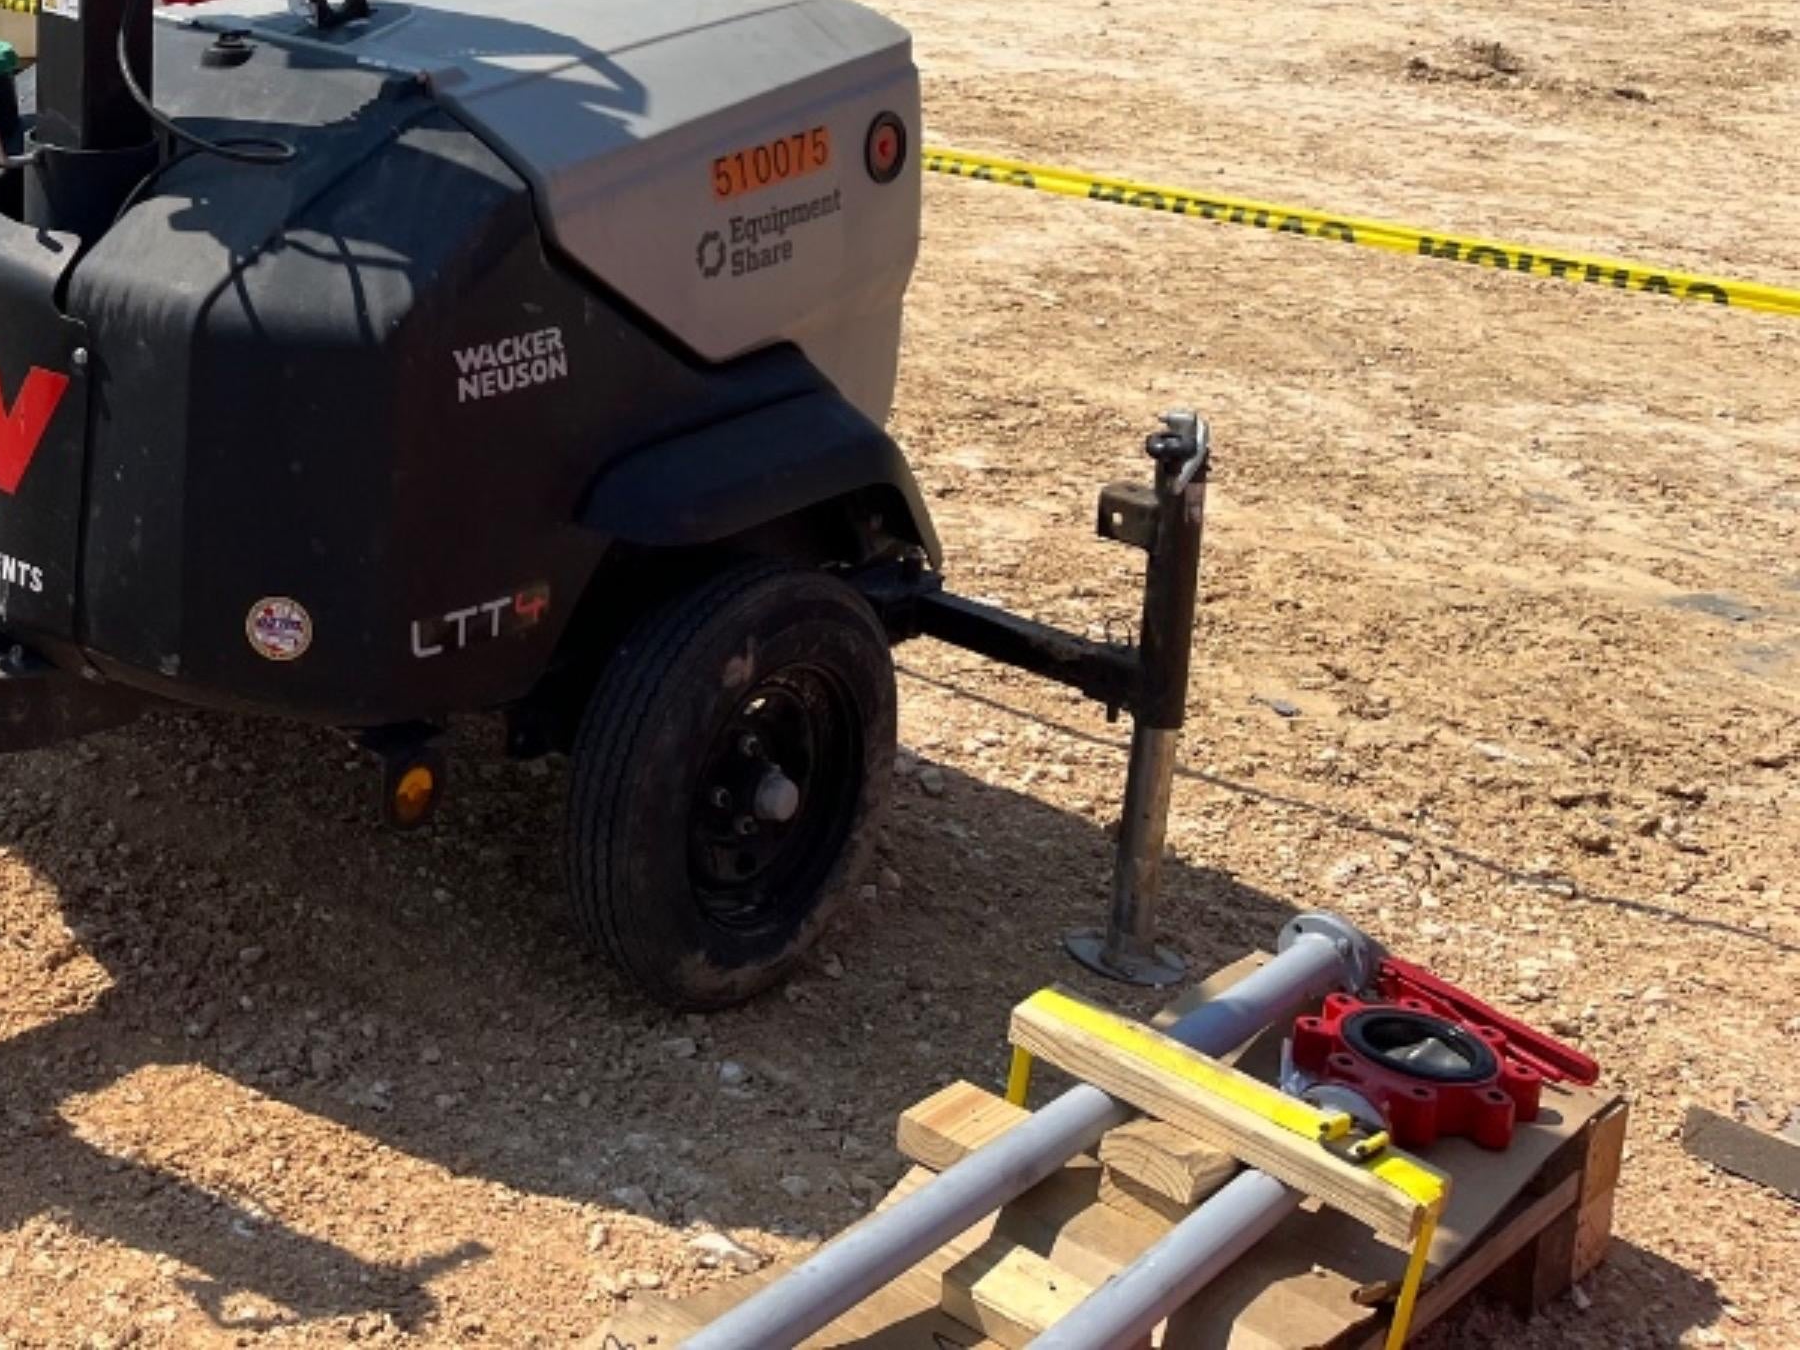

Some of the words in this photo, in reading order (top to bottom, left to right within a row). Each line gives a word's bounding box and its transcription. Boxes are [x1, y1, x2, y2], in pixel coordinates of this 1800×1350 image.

[713, 125, 829, 197] 510075
[728, 188, 842, 245] Equipment
[730, 239, 793, 278] Share
[452, 326, 565, 374] WACKER
[457, 351, 568, 403] NEUSON
